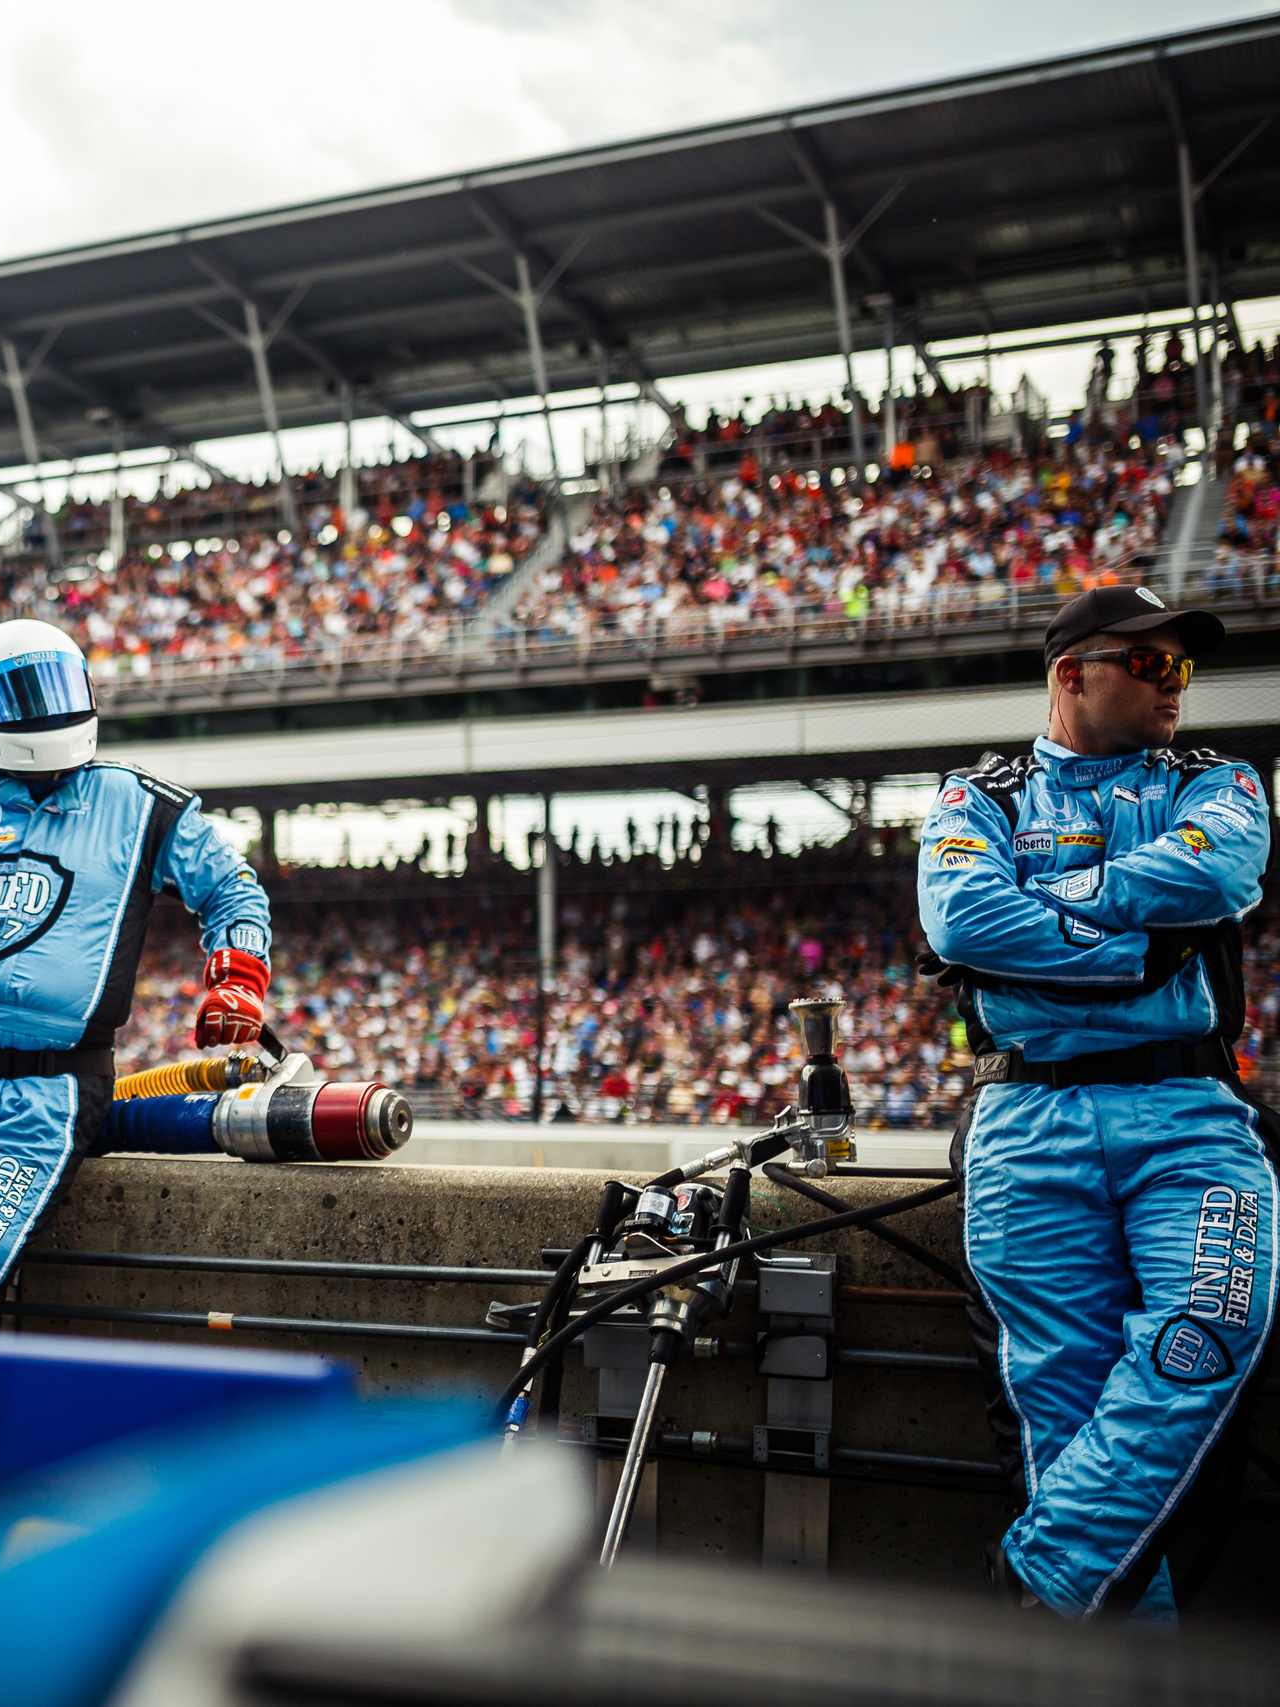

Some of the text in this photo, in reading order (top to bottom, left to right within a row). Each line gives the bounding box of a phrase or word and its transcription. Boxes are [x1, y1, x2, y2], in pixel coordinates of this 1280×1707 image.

[1141, 783, 1167, 793] erizon
[941, 814, 964, 830] UFD
[1030, 818, 1104, 833] HONDA
[1015, 837, 1051, 852] Oberto
[1062, 835, 1100, 845] DHL
[1176, 828, 1215, 853] SUNOCO
[945, 854, 971, 868] NAPA
[8, 1164, 38, 1207] DATA
[0, 1202, 17, 1219] &
[1188, 1185, 1237, 1319] UNITED
[1223, 1190, 1259, 1329] FIBER & DATA
[1163, 1326, 1204, 1373] UFD
[1202, 1350, 1220, 1375] 27
